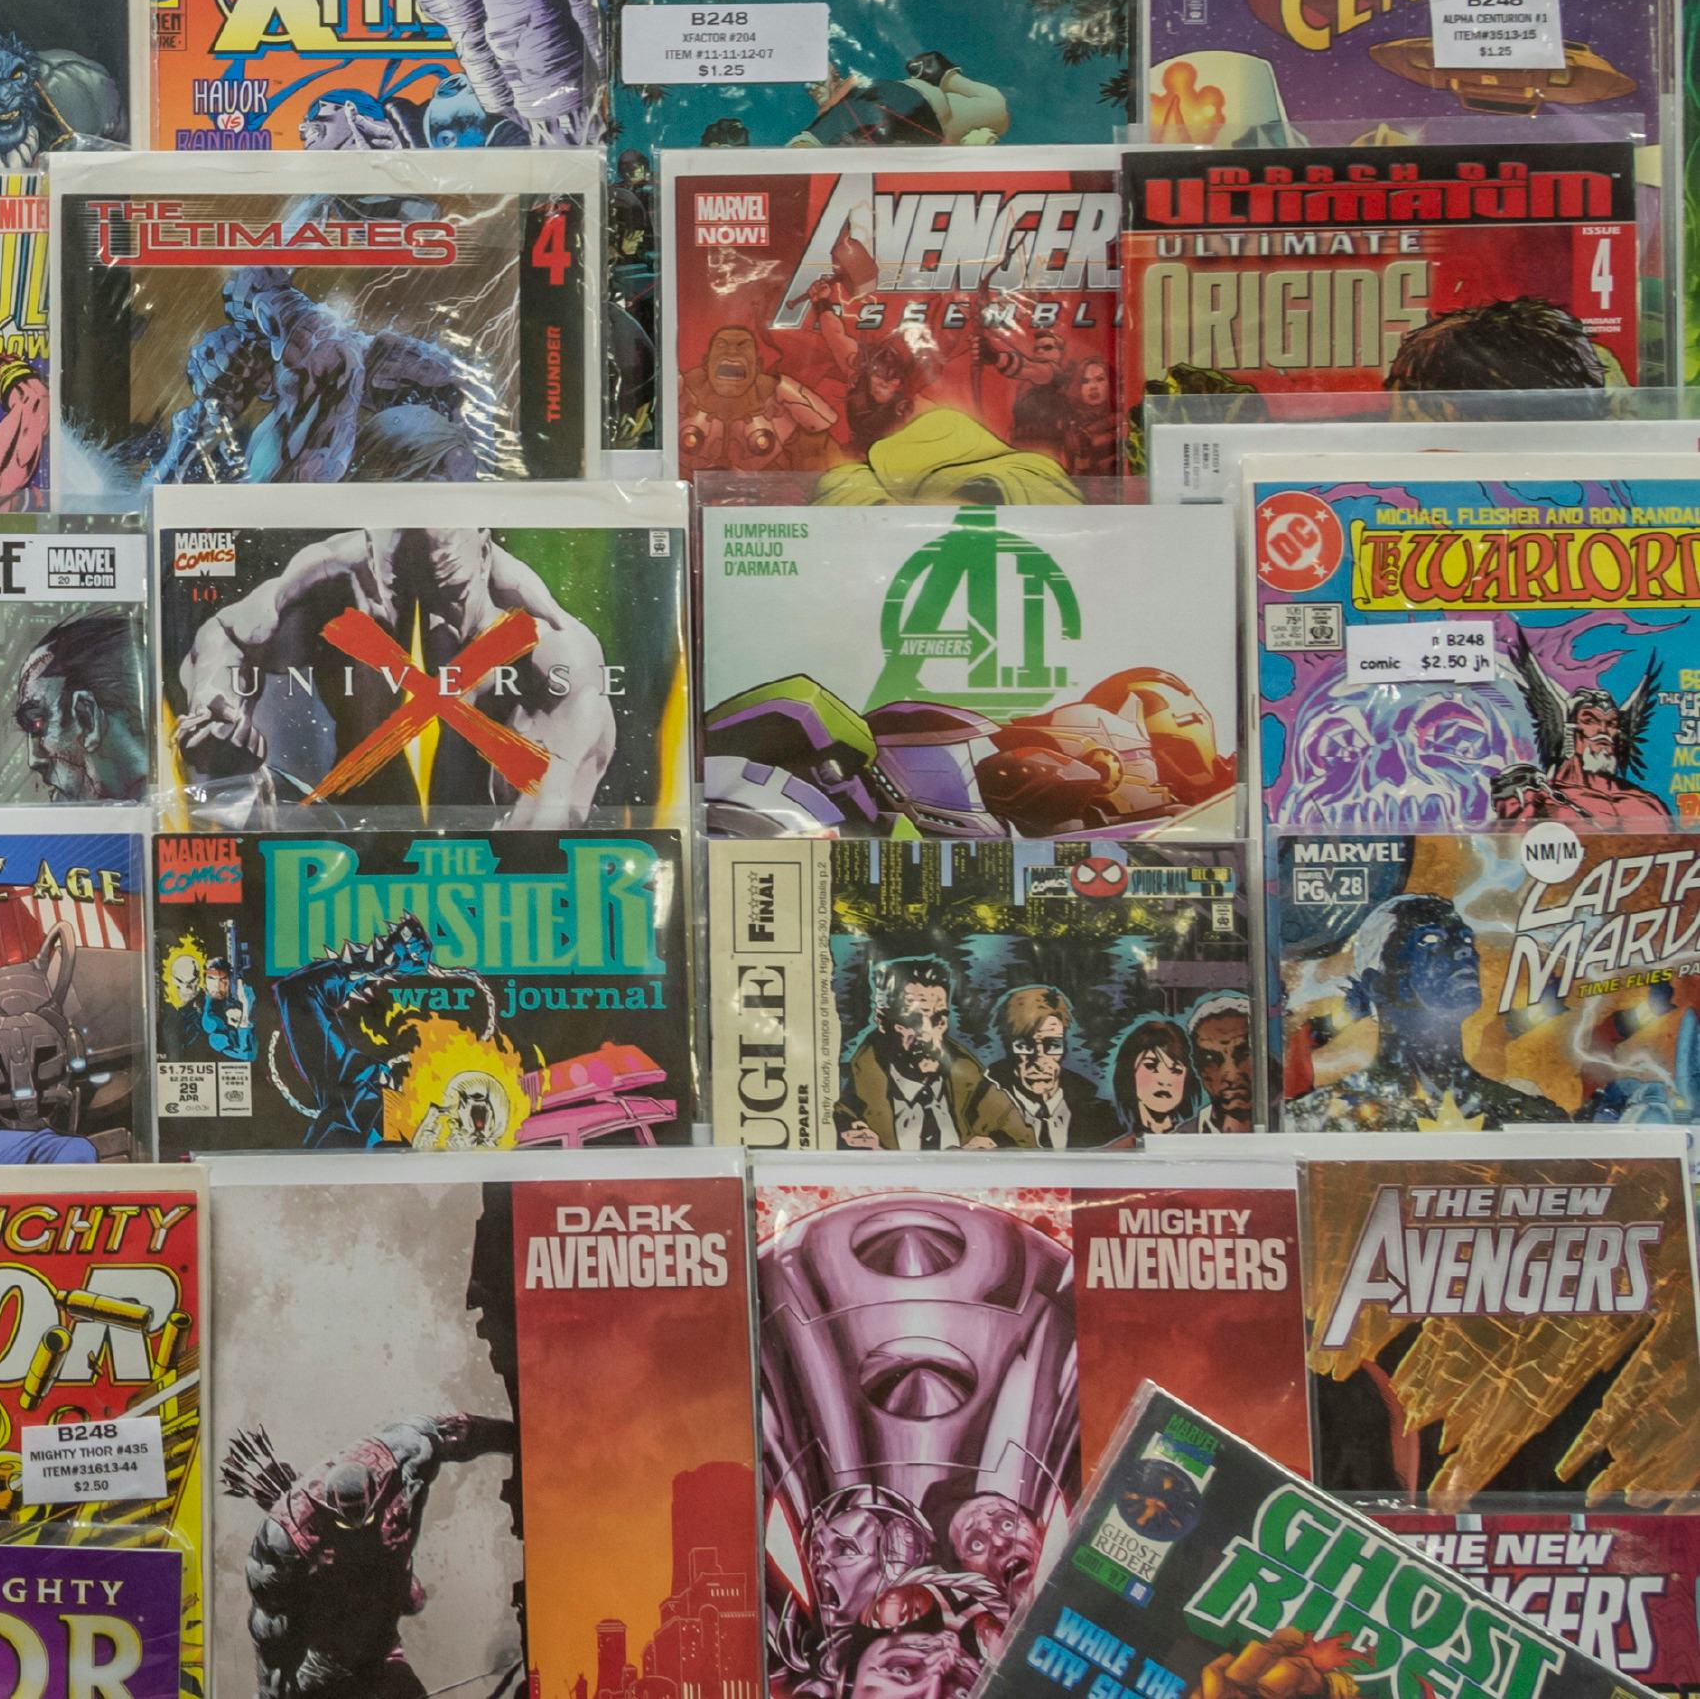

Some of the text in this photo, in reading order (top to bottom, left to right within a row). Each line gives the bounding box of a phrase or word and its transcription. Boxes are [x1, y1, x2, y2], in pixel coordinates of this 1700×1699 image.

[691, 12, 748, 26] B248
[698, 64, 744, 76] $1.25
[97, 222, 458, 265] ULTIMATES
[698, 227, 766, 244] NOW!
[1158, 232, 1422, 257] ULTIMATE
[1149, 266, 1429, 375] ORIGINS
[1377, 507, 1626, 525] MICHAEL FLEISHER AND RON
[724, 524, 808, 539] HUMPHRIES
[1525, 845, 1578, 860] NM/M
[556, 1205, 692, 1233] DARK
[1119, 1210, 1250, 1235] MIGHTY
[525, 1234, 728, 1289] AVENGERS
[1086, 1238, 1287, 1291] AVENGERS
[58, 1425, 117, 1441] B248
[30, 1443, 148, 1461] MIGHTY THOR #435
